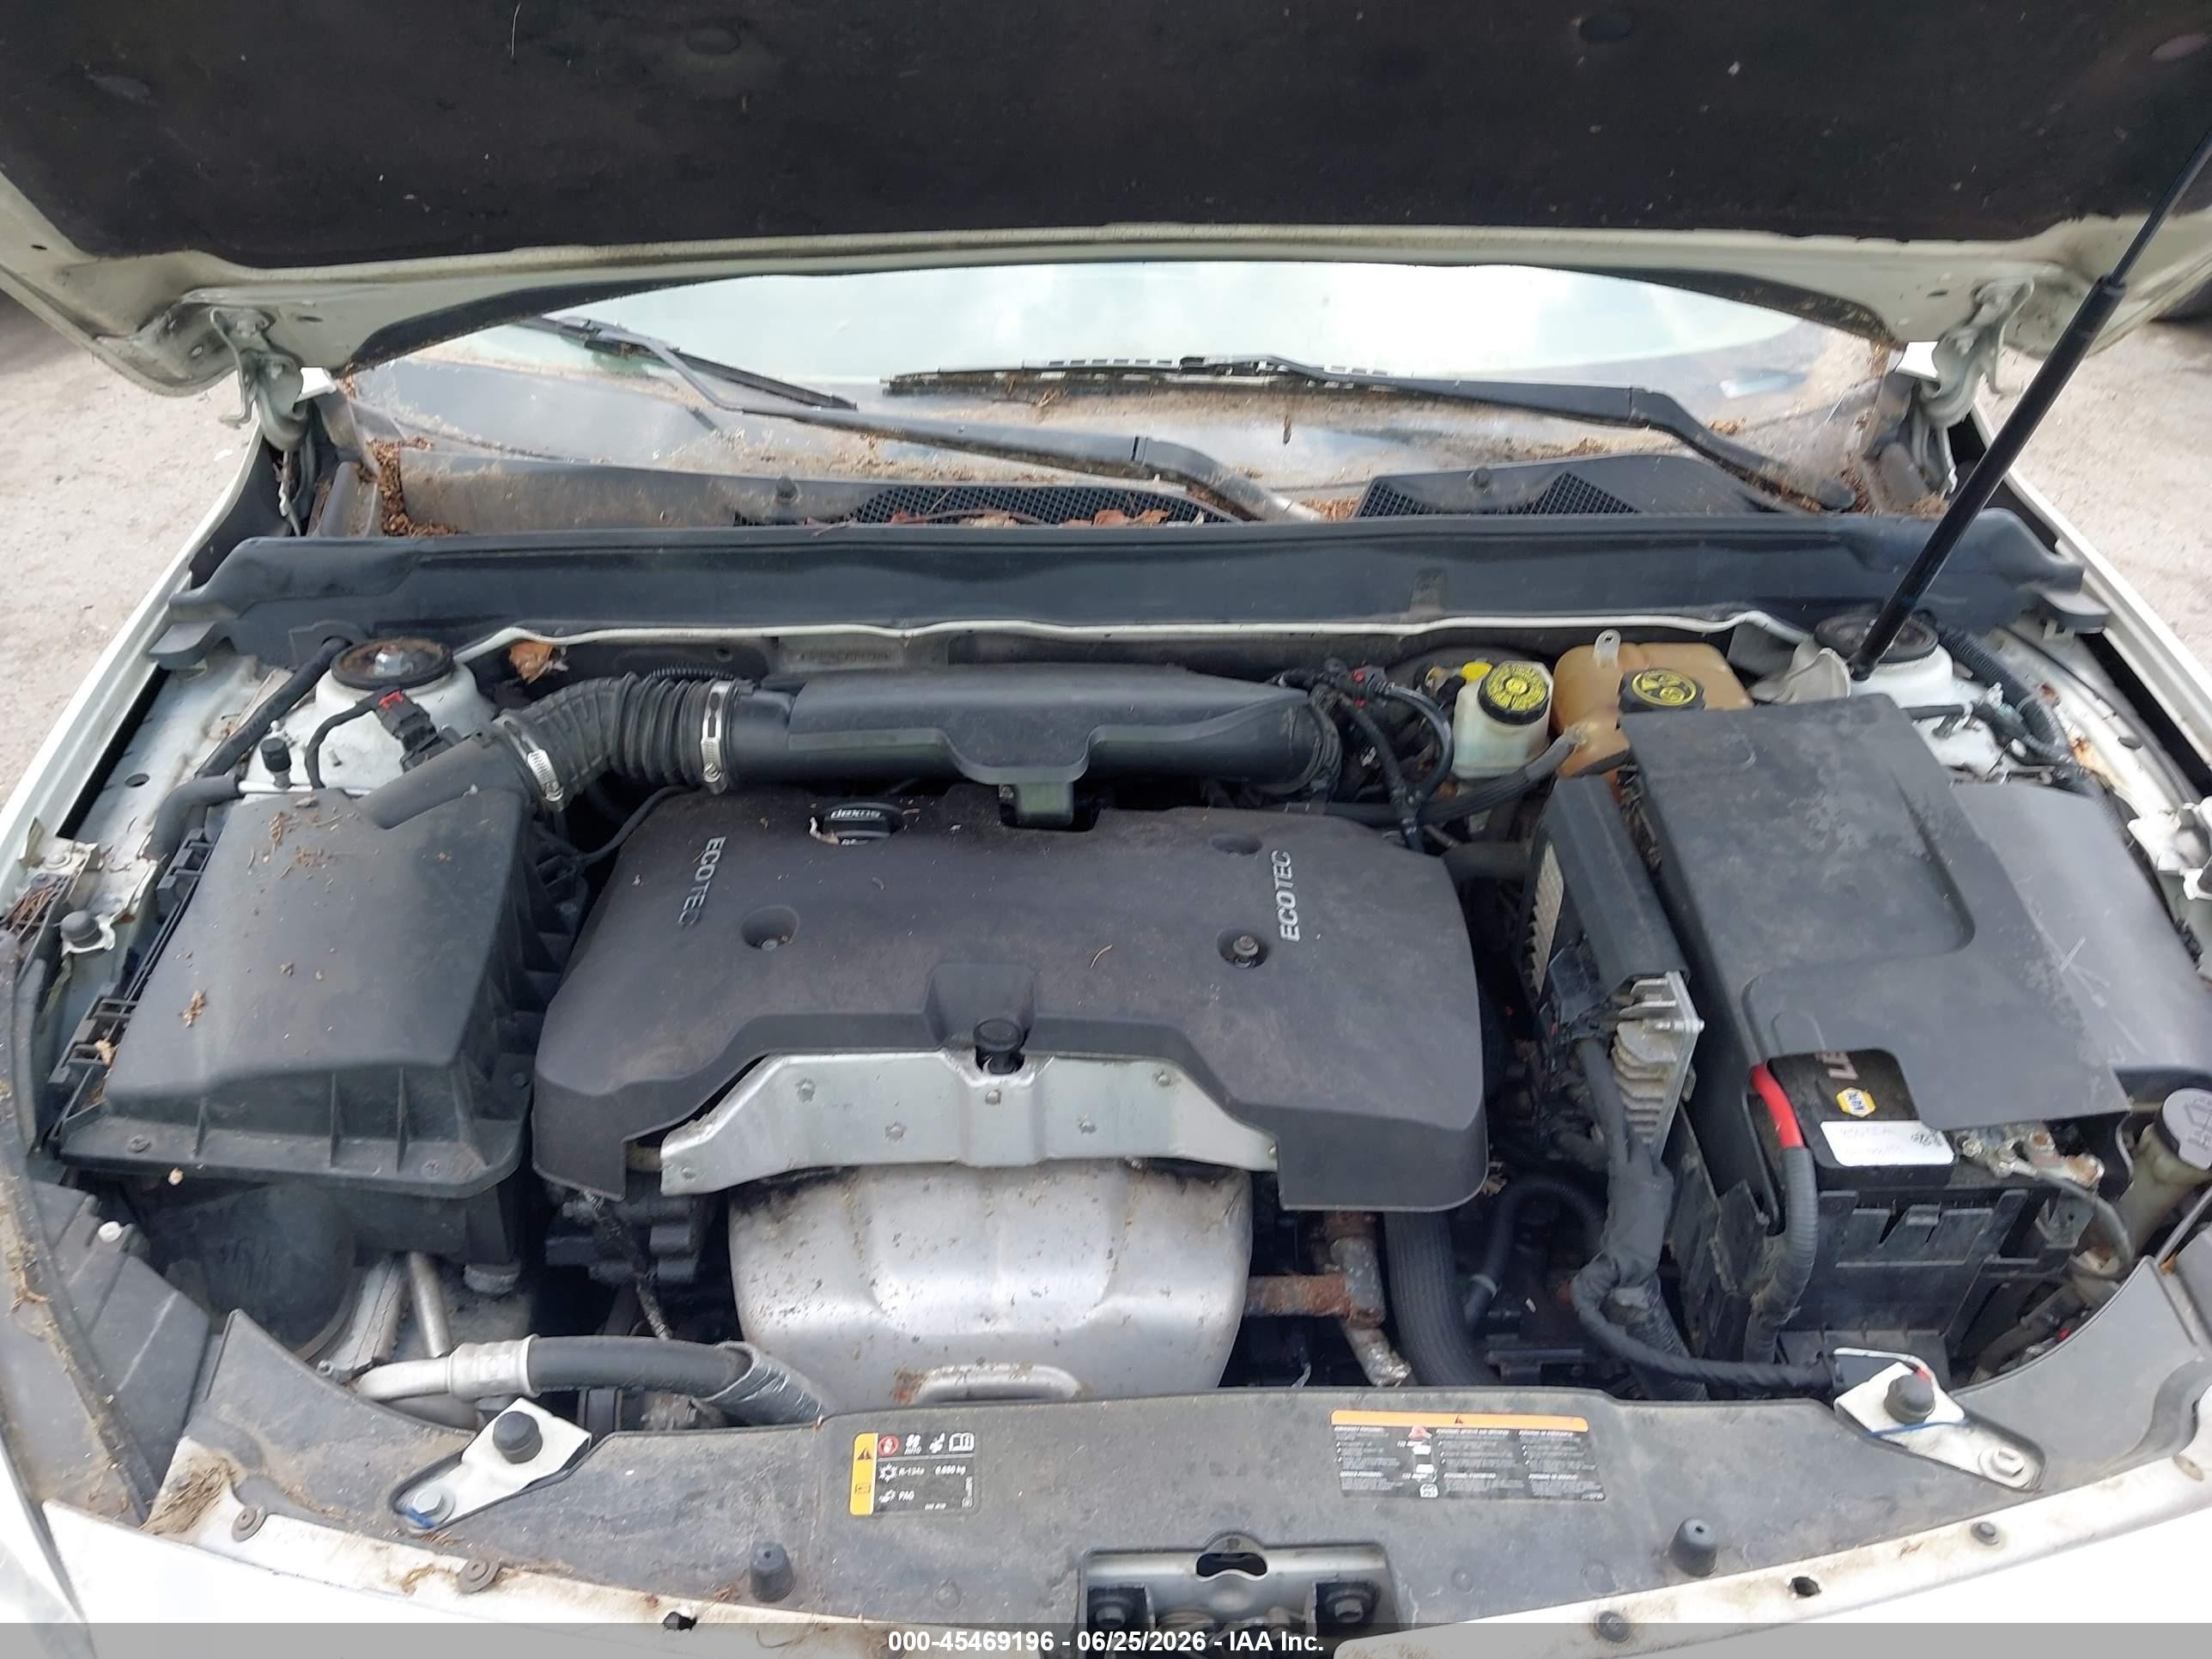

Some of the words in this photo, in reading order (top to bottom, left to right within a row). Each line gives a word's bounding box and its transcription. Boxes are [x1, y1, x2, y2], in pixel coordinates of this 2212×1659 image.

[830, 808, 881, 819] dexos
[678, 836, 727, 927] ECOTEC
[1271, 849, 1300, 942] ECOTEC
